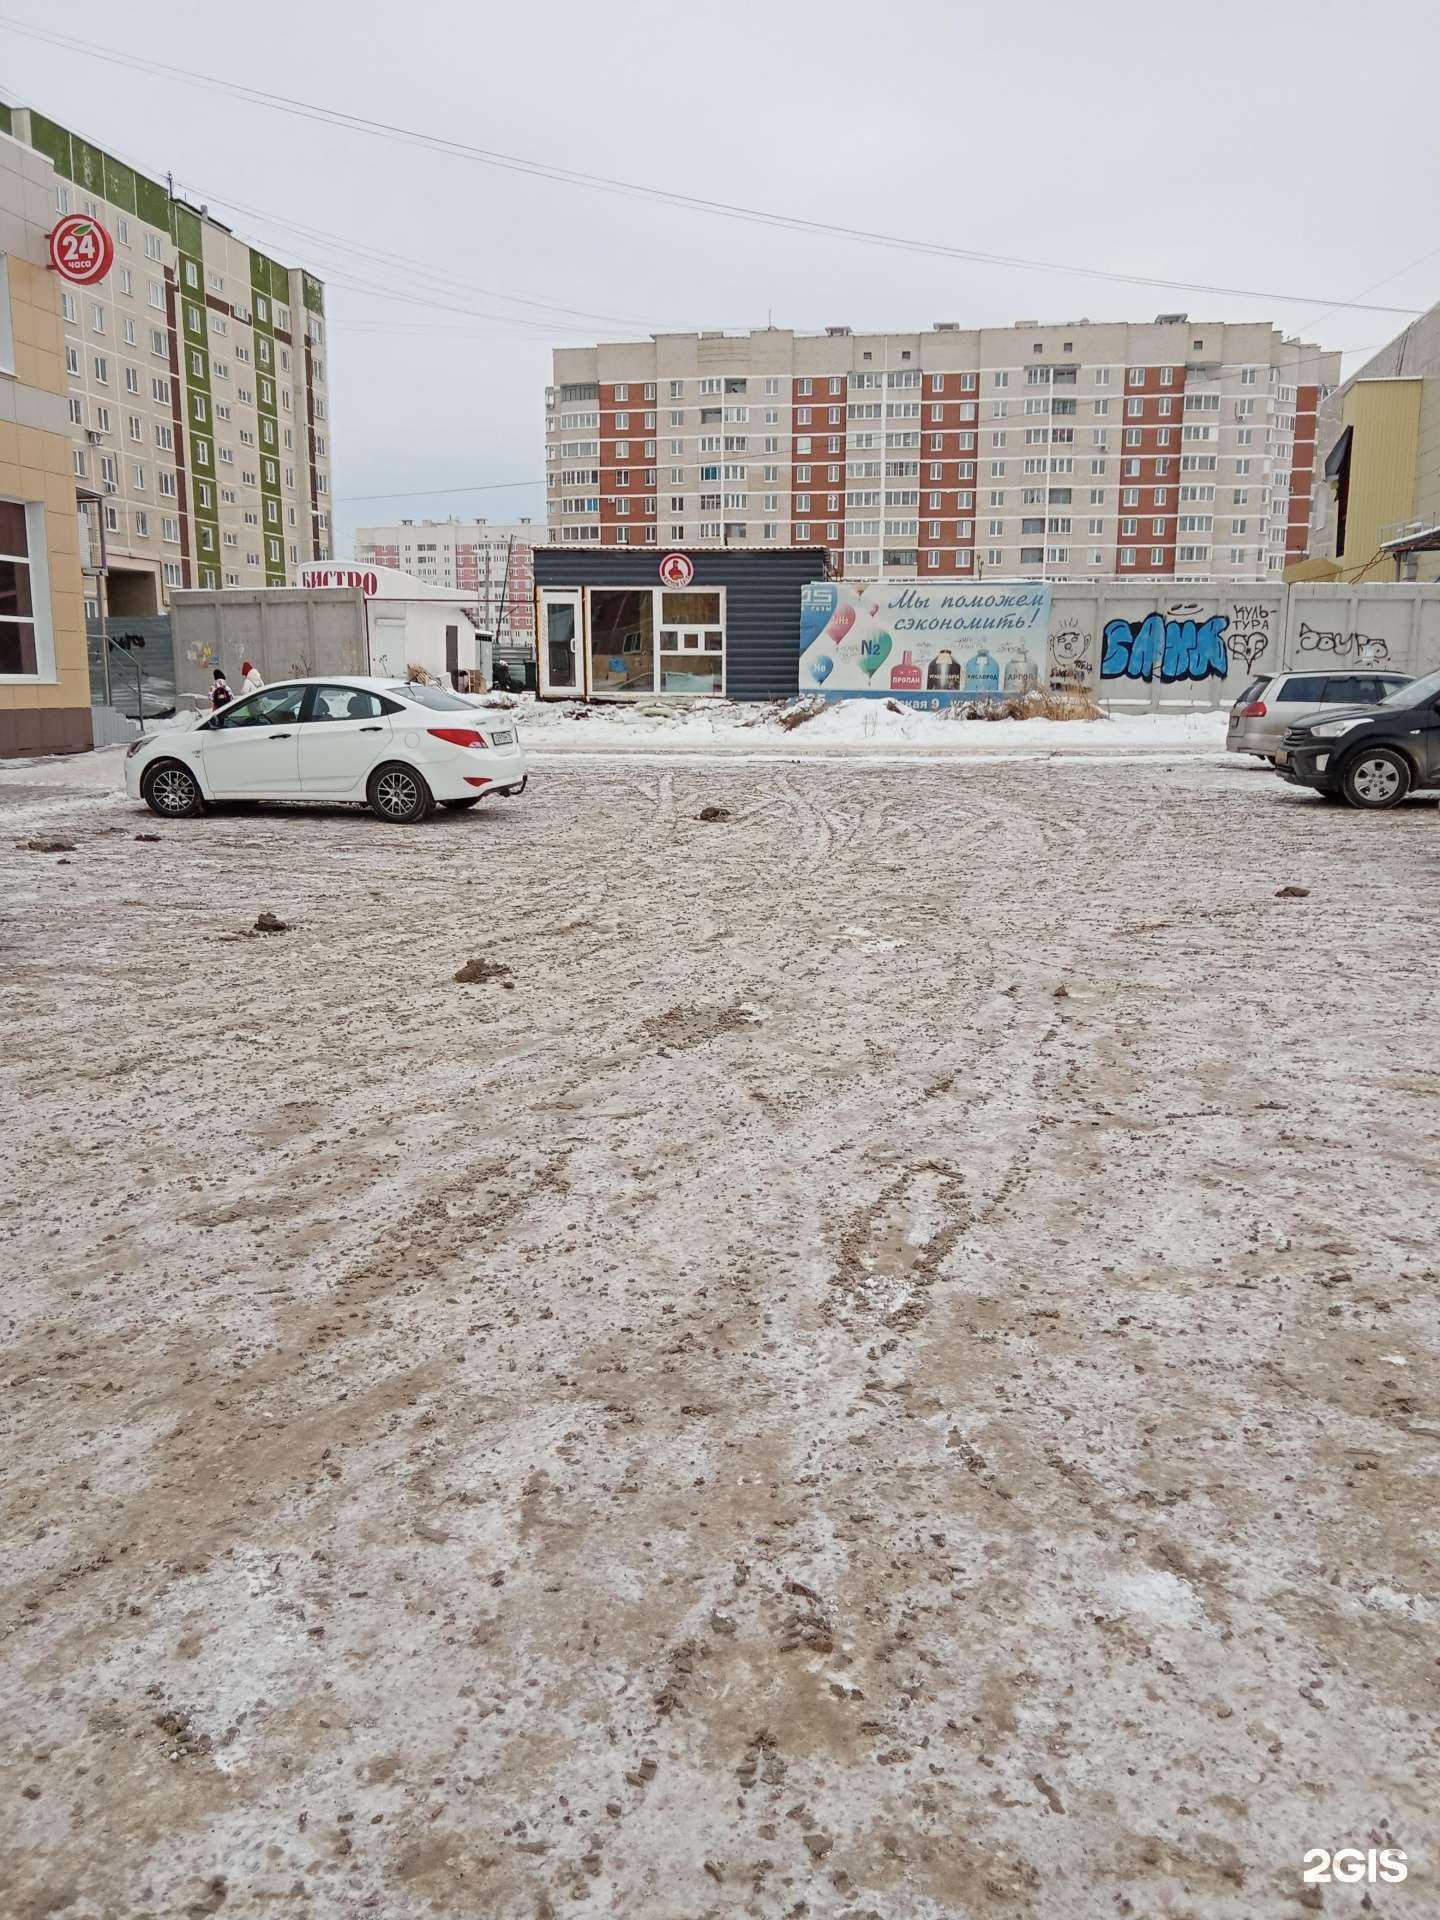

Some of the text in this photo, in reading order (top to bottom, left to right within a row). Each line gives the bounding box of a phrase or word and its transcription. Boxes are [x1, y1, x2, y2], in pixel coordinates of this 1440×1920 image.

[62, 235, 96, 260] 24
[68, 261, 92, 269] часа
[302, 571, 378, 596] БИСТРО
[888, 589, 1045, 609] Мы поможем
[894, 607, 1041, 631] сэкономить!
[1232, 619, 1270, 631] ТУРА
[861, 639, 881, 656] N2
[892, 675, 921, 684] ПРОПАН
[931, 698, 940, 710] 9
